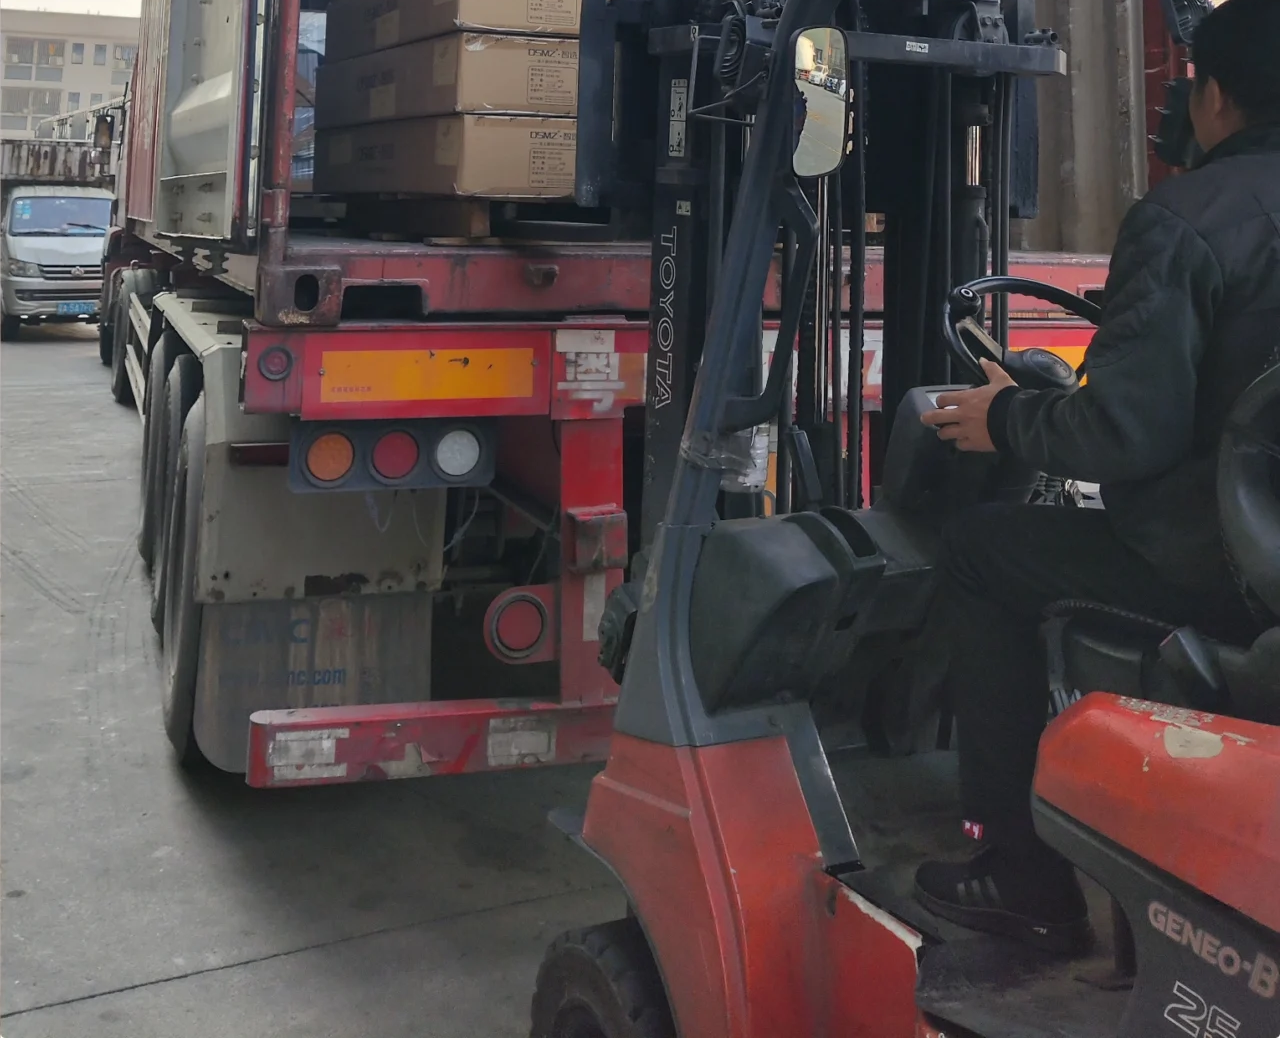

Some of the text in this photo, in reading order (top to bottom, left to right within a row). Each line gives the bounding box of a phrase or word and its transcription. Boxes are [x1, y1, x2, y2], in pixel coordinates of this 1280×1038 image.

[528, 48, 556, 57] DSMZ
[530, 131, 558, 139] DSMZ
[655, 226, 677, 409] TOYOTA
[1148, 900, 1279, 999] GENEO-B
